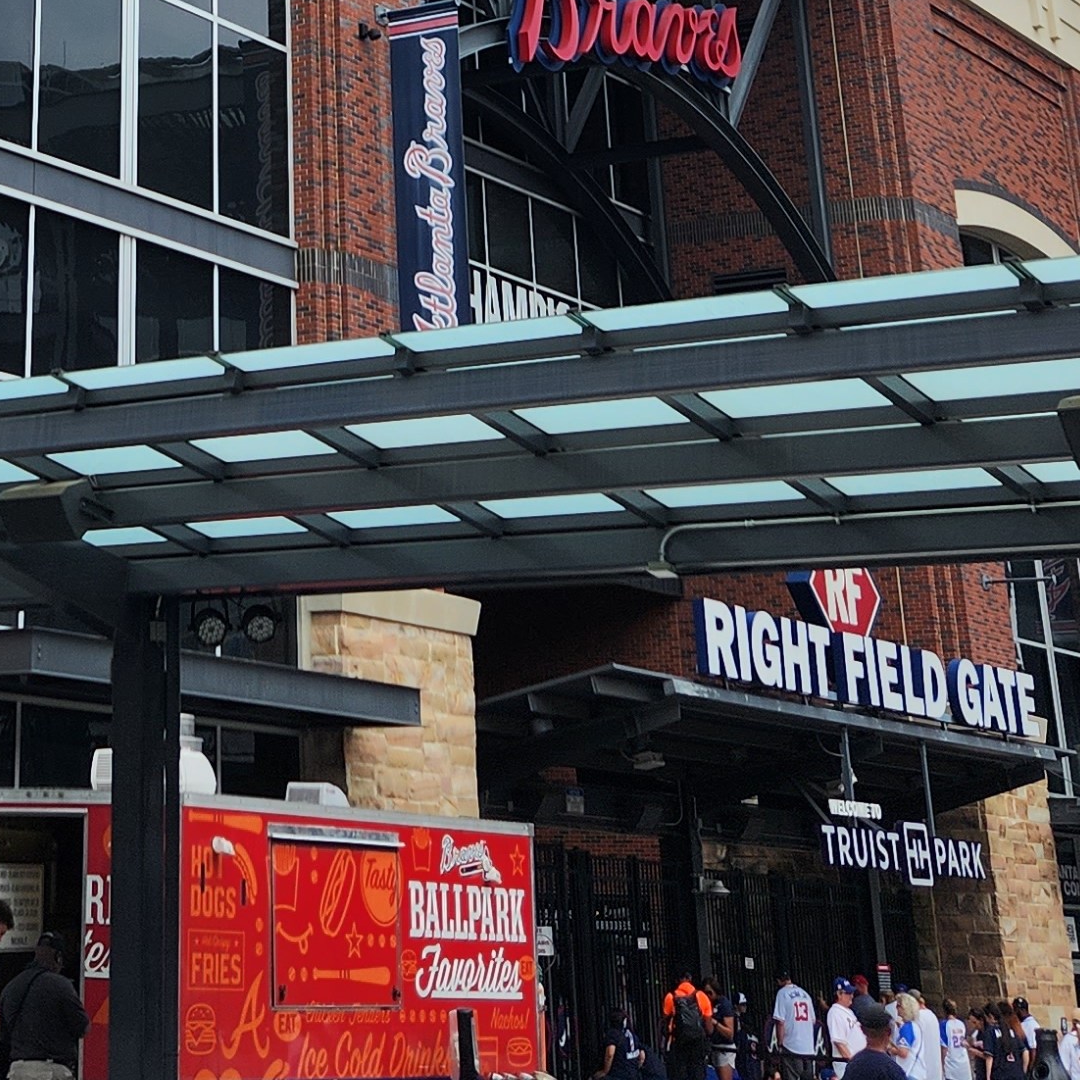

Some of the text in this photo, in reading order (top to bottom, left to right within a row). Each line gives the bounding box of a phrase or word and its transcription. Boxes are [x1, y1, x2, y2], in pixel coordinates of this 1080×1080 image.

[404, 35, 455, 187] Braves
[824, 568, 863, 626] RF
[703, 597, 1040, 738] RIGHT FIELD GATE
[828, 798, 870, 818] WELCOME
[821, 824, 987, 880] TRUIST PARK
[190, 884, 237, 919] DOGS
[408, 880, 527, 943] BALLPARK
[191, 952, 242, 985] FRIES
[415, 943, 524, 999] Favorites
[279, 1013, 297, 1034] EAT
[491, 1006, 530, 1031] Nachos!
[794, 1001, 809, 1022] 13
[298, 1031, 328, 1079] Ice
[335, 1030, 387, 1078] Cold
